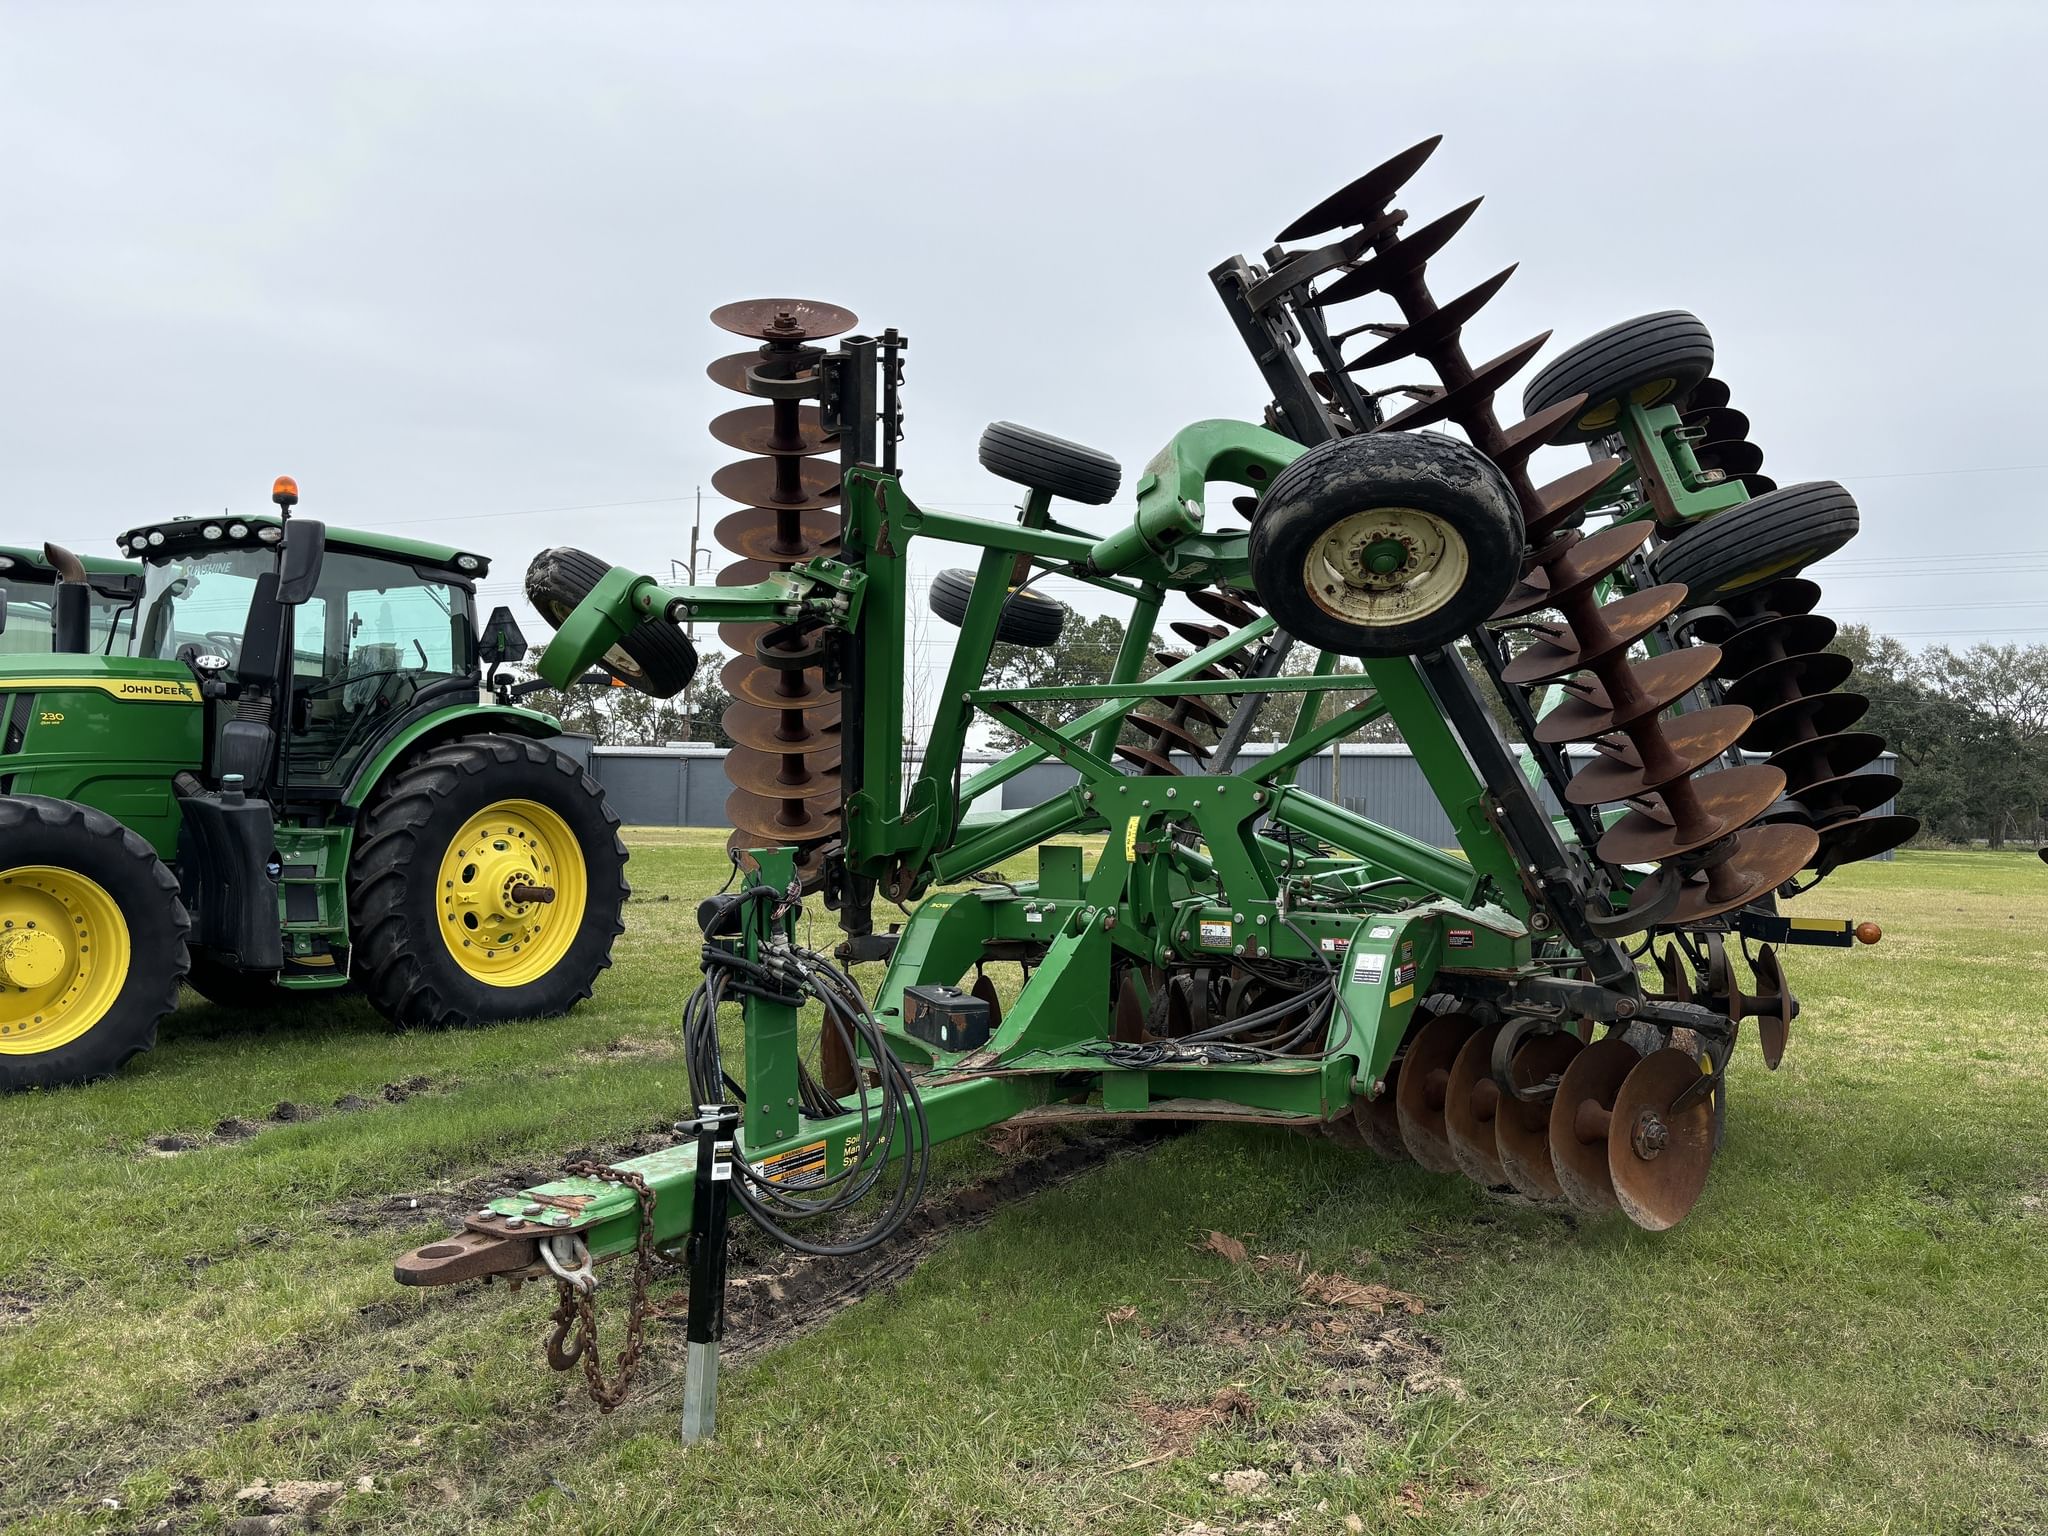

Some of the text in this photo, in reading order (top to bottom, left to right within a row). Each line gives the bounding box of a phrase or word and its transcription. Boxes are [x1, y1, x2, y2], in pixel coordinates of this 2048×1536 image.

[184, 562, 232, 577] SUNSHINE
[120, 683, 152, 694] JOHN
[40, 712, 65, 721] 230
[845, 1133, 861, 1146] Soil
